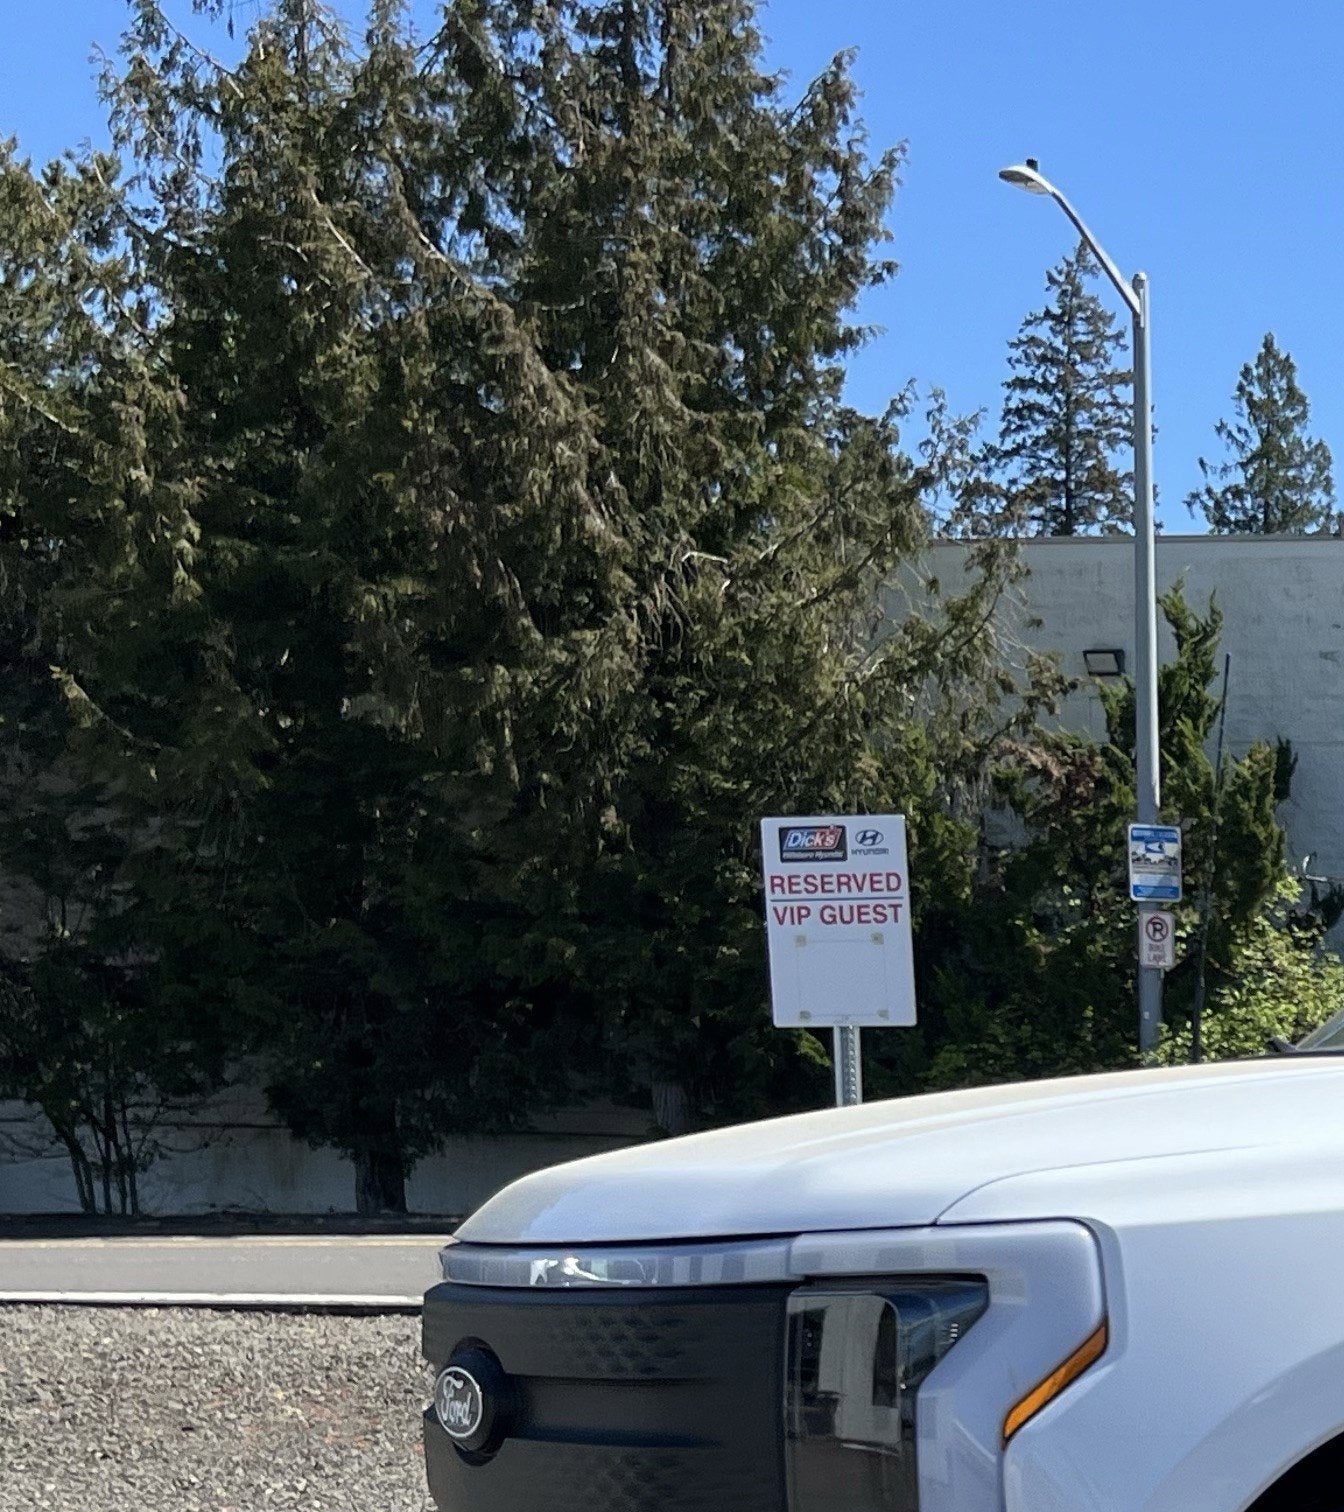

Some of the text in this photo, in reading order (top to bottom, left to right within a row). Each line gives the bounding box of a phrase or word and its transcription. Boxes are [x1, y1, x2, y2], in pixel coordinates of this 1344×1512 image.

[769, 872, 901, 895] RESERVED
[773, 904, 903, 925] VIP GUEST
[441, 1374, 472, 1426] Ford
